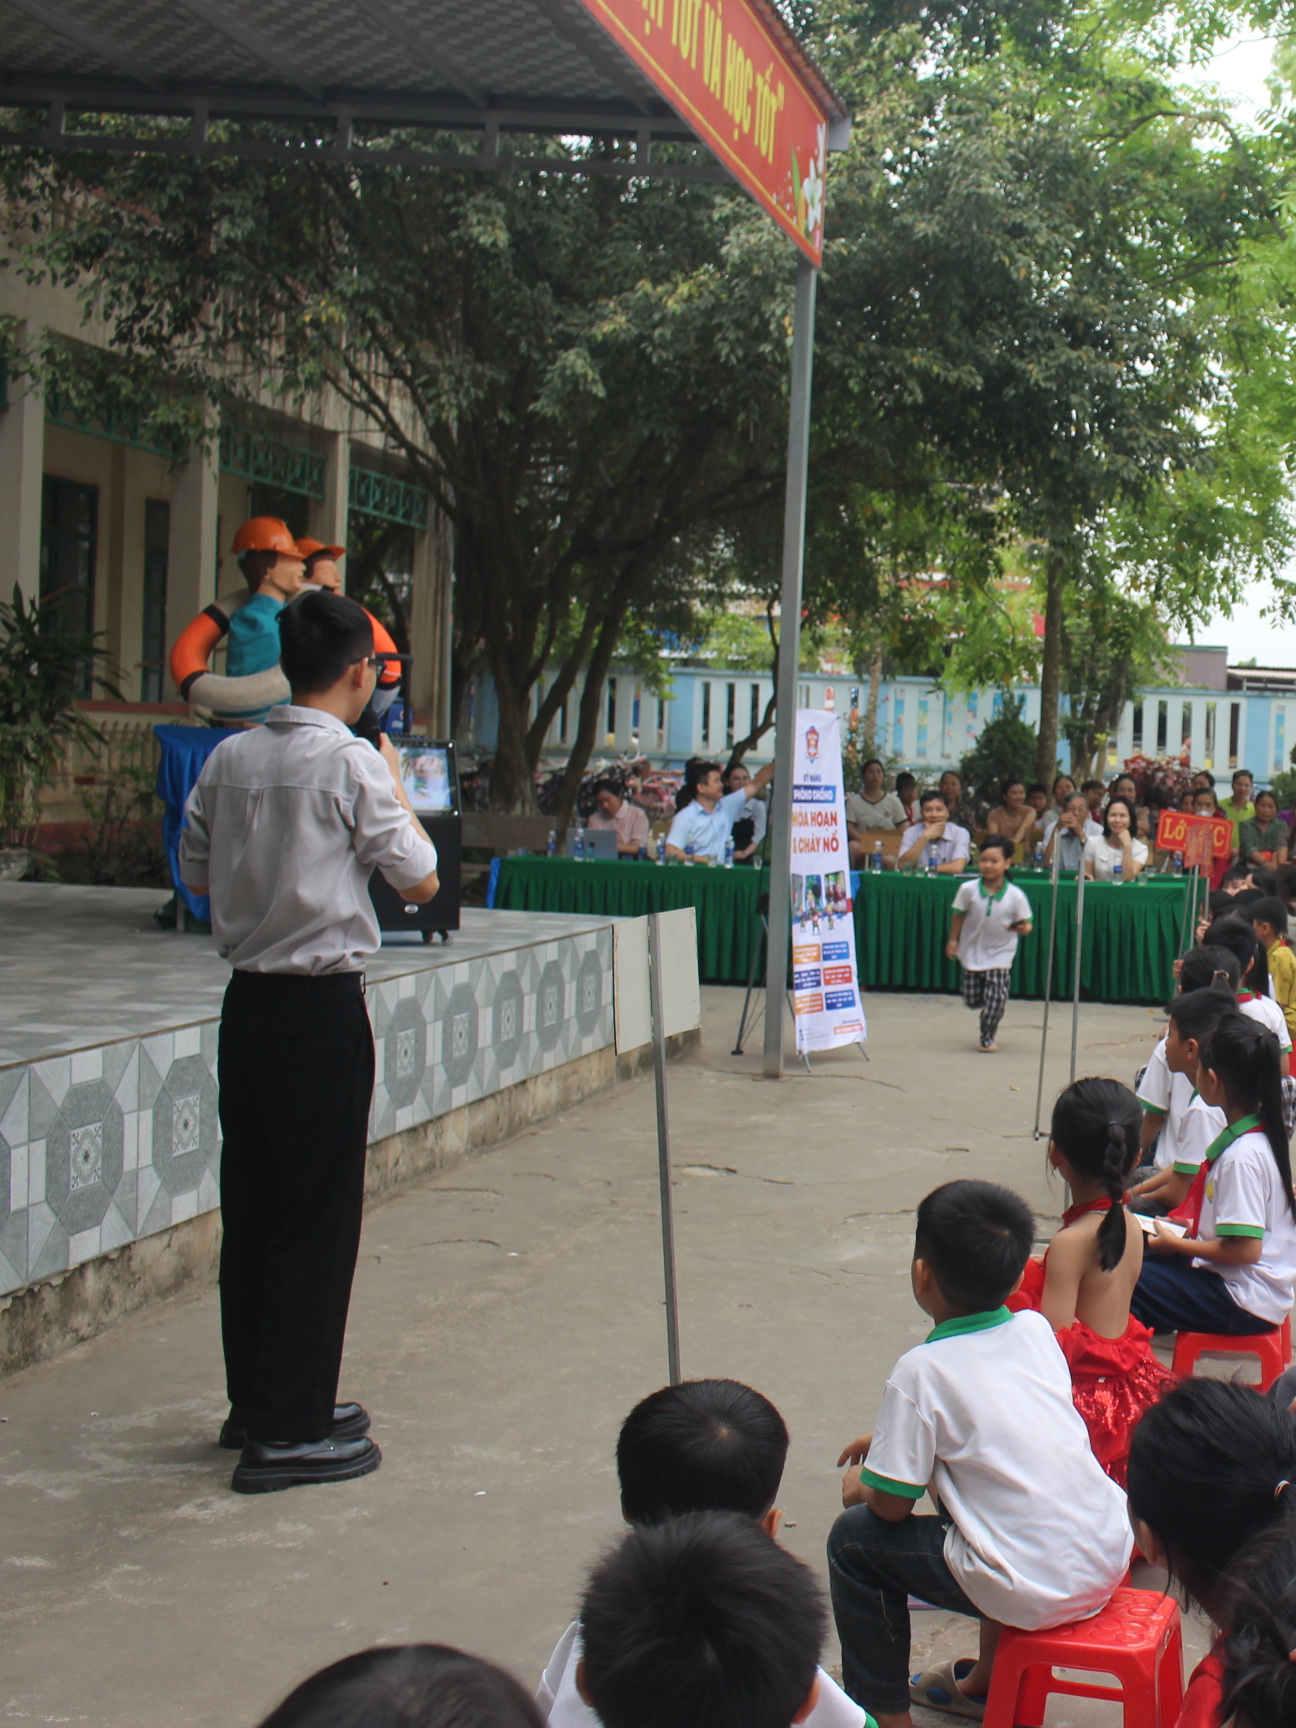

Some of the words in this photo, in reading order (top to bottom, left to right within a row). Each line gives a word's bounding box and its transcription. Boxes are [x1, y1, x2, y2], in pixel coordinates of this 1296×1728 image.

[723, 32, 753, 141] HỌC
[811, 811, 838, 831] HOẠN
[799, 833, 821, 853] CHÁY
[823, 829, 839, 853] NỔ
